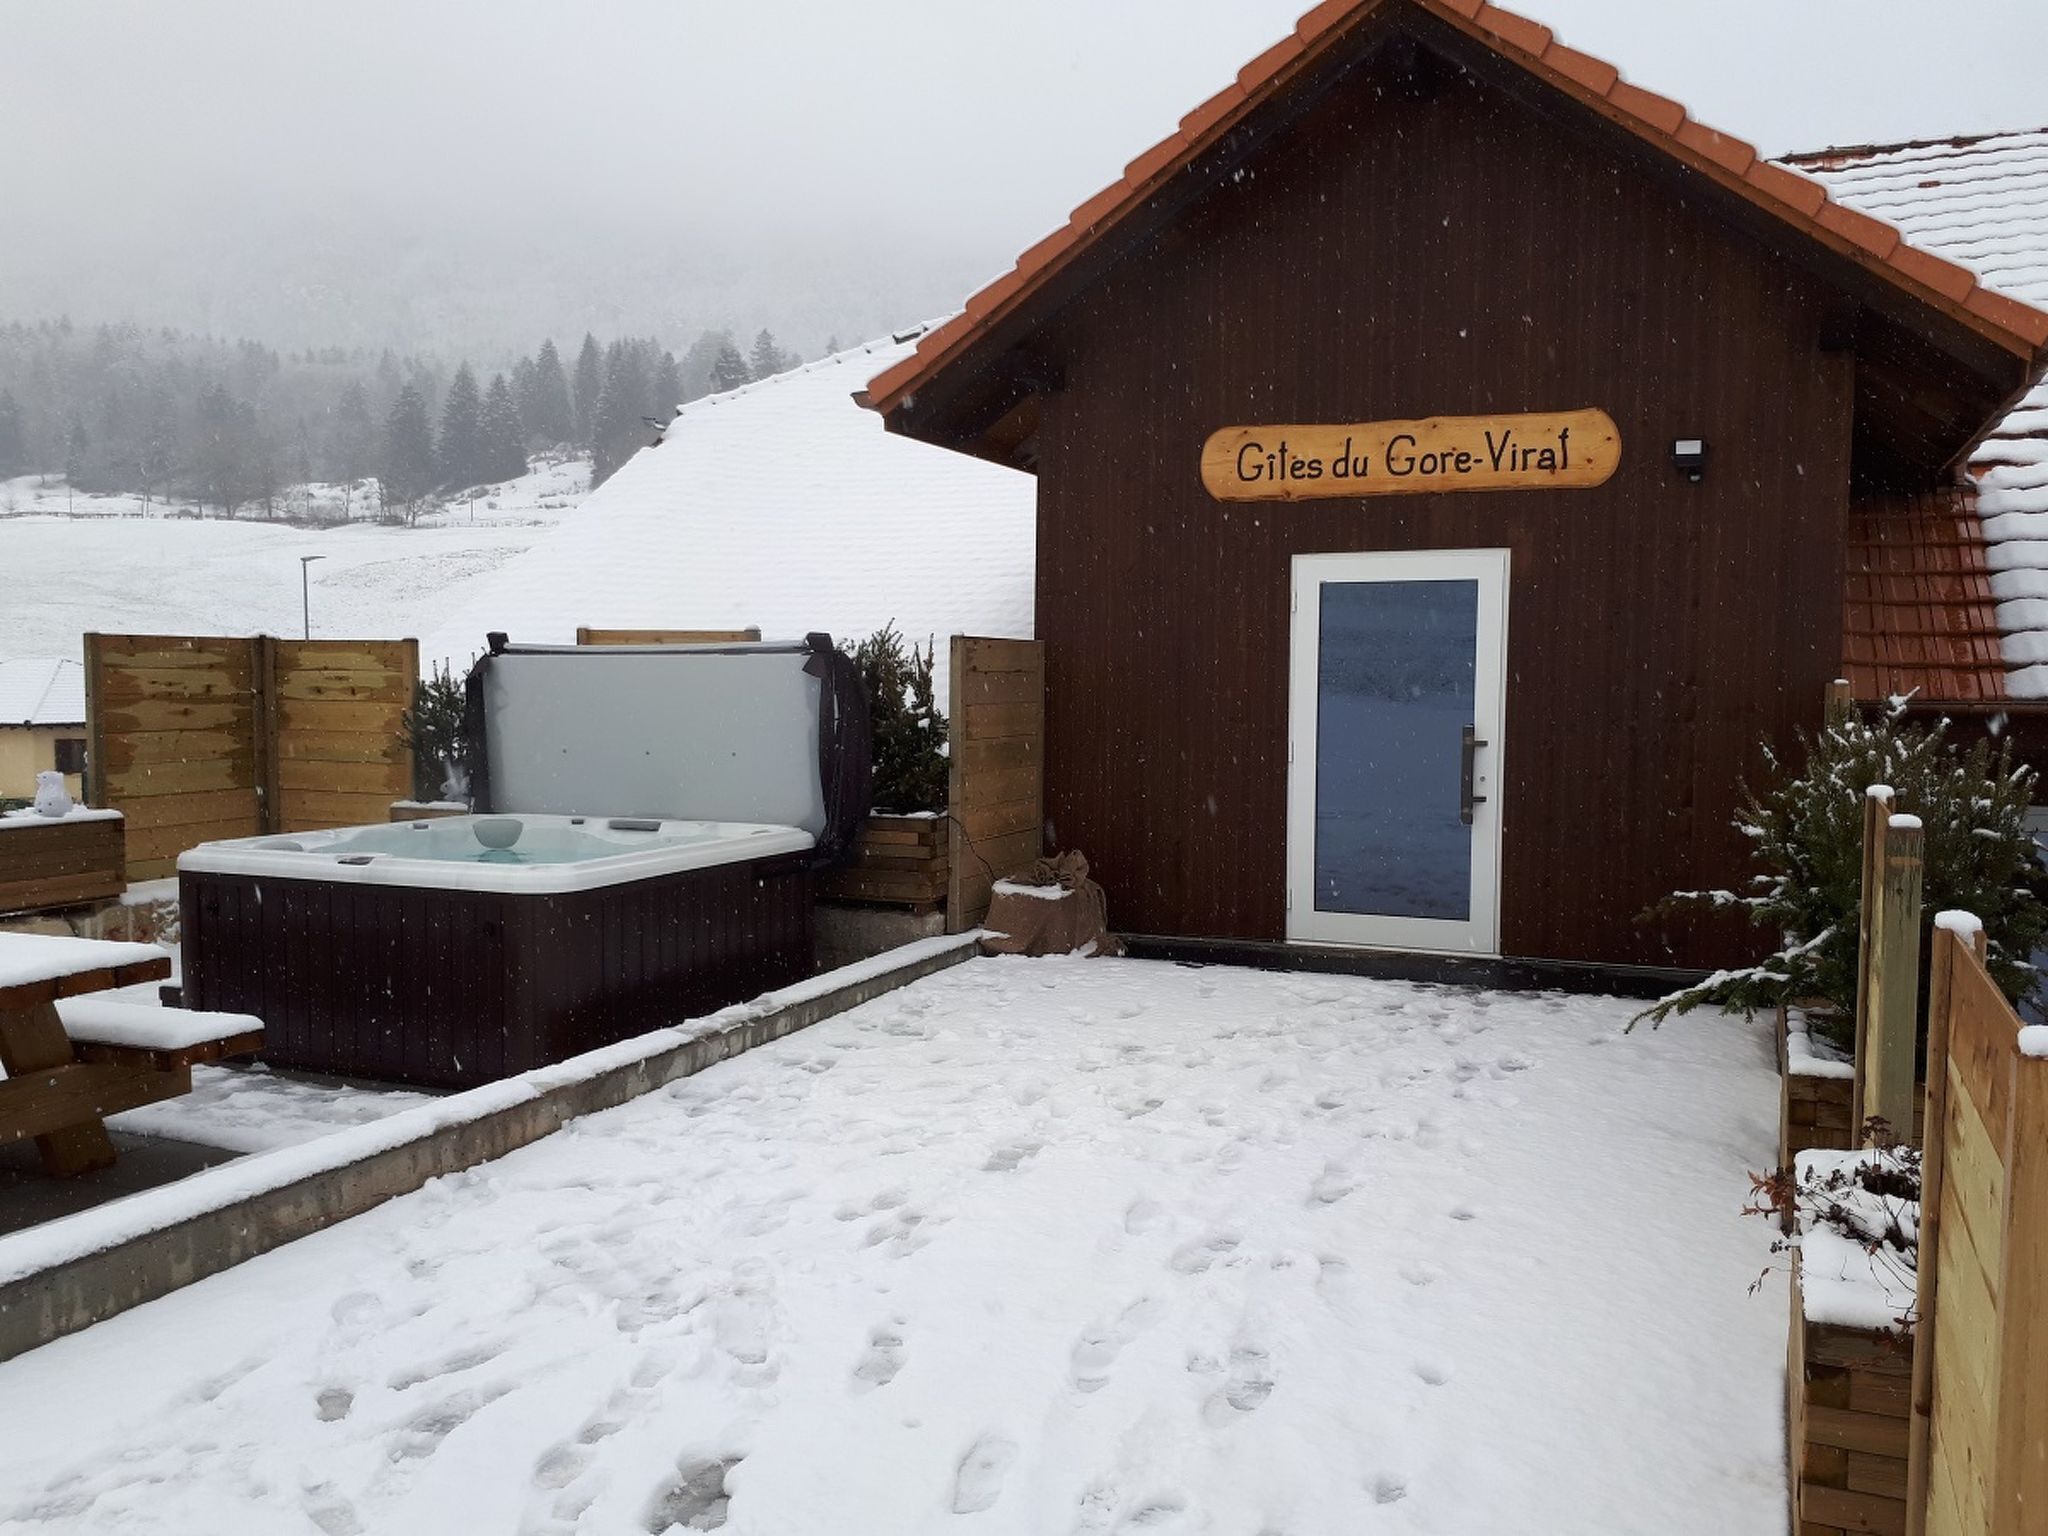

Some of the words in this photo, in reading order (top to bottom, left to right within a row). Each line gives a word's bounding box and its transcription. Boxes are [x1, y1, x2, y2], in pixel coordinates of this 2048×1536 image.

[1237, 440, 1324, 482] Gîtes
[1332, 437, 1369, 478] du
[1385, 428, 1570, 476] Gore-Virat
